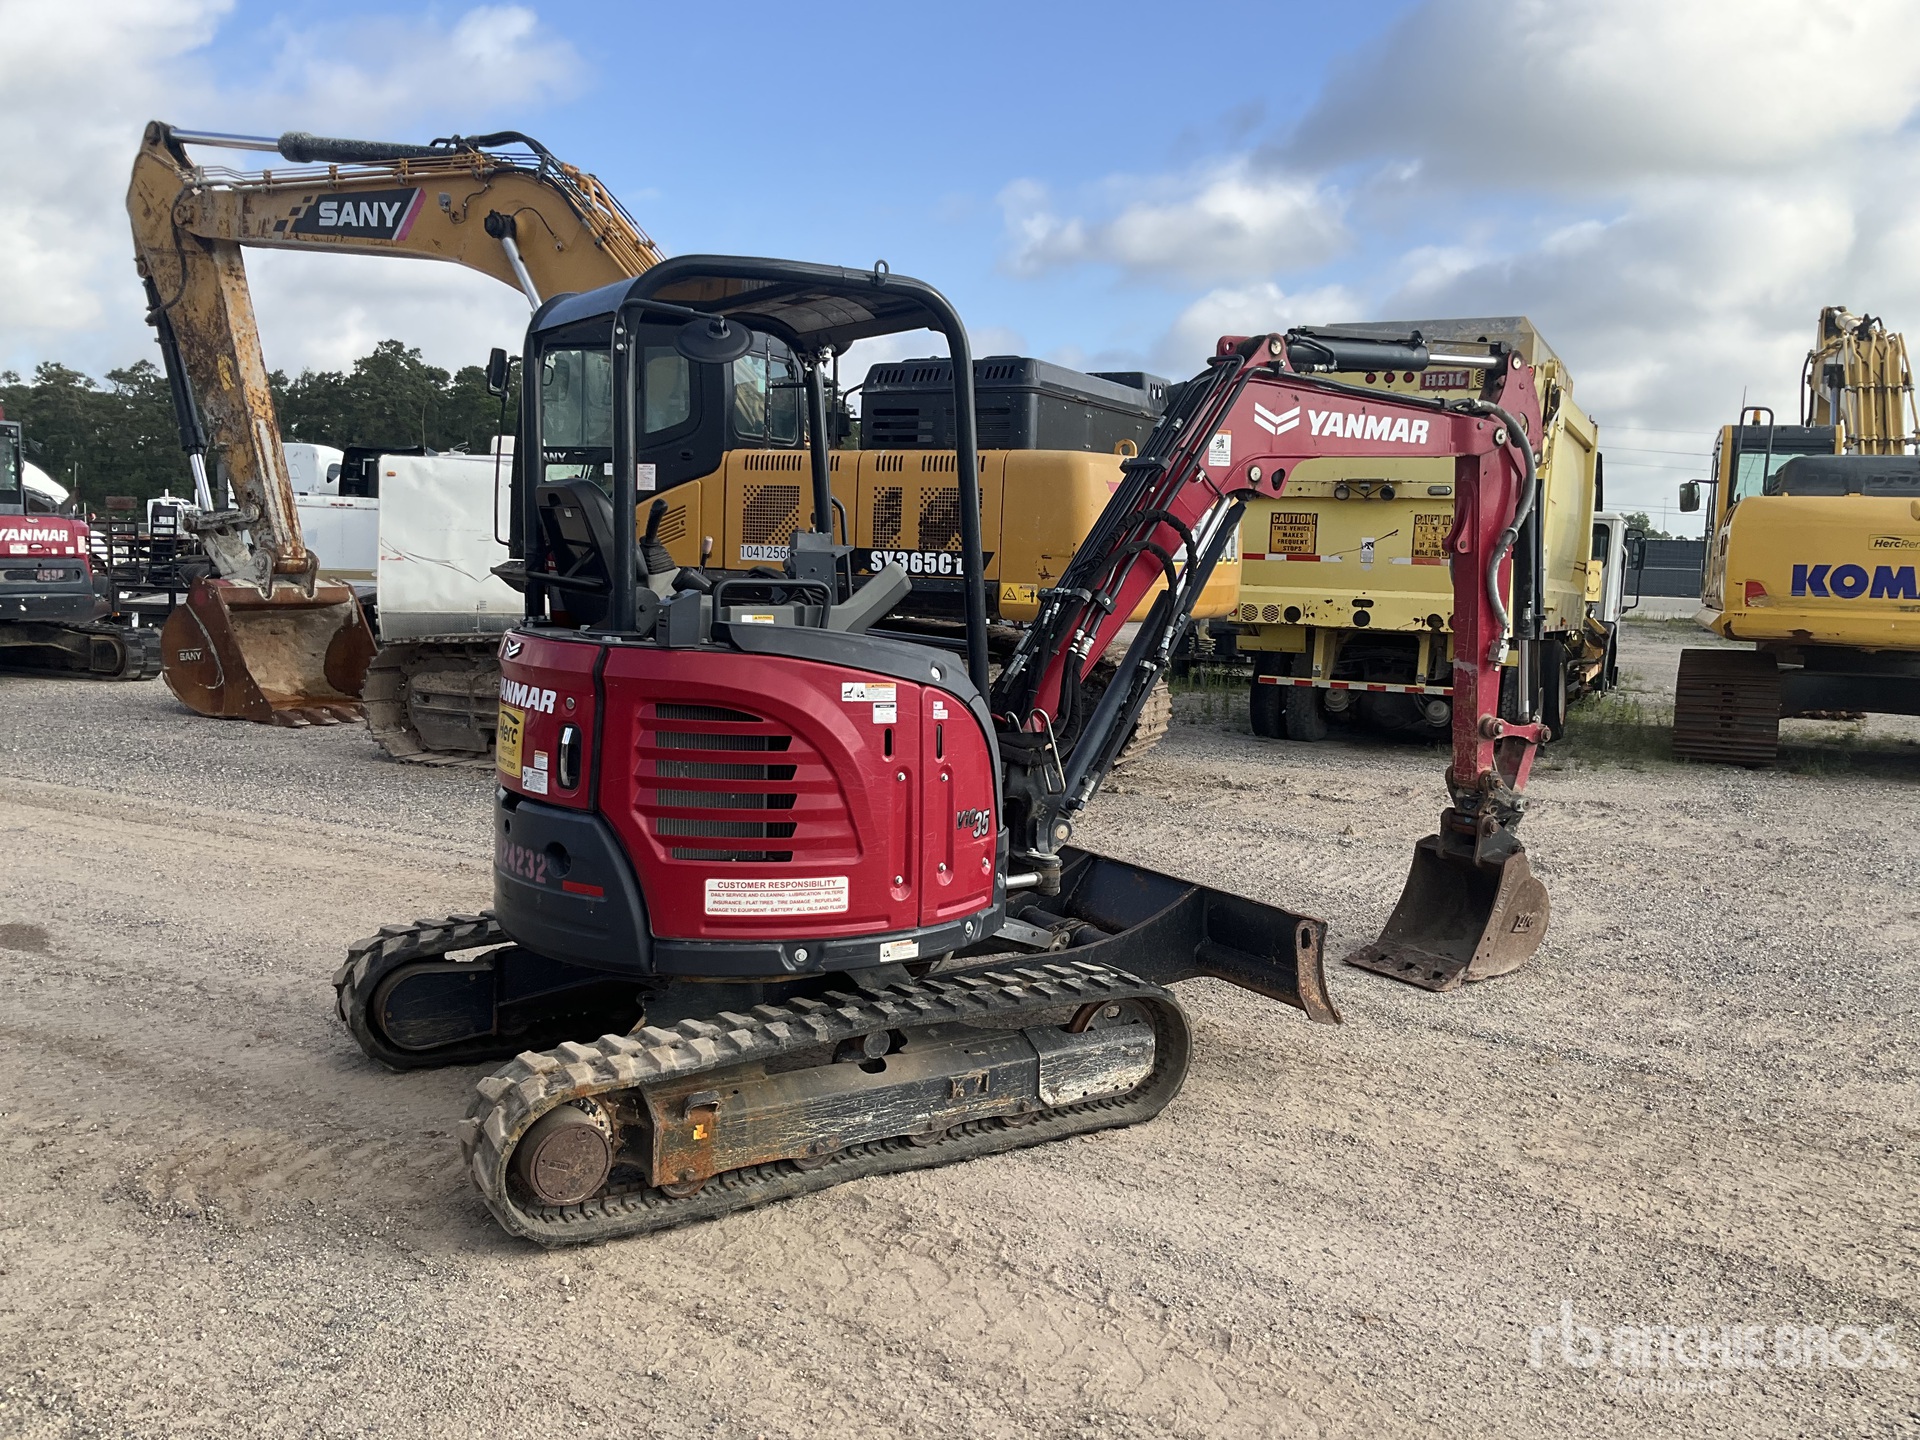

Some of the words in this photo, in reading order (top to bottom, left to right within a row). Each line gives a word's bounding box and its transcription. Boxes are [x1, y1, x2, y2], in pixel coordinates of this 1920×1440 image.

[318, 201, 401, 227] SANY
[1425, 373, 1465, 387] HEIL
[1307, 409, 1429, 444] YANMAR
[542, 452, 566, 462] ANY
[1791, 564, 1920, 599] KOM
[179, 651, 201, 661] SANY
[500, 676, 556, 714] ANMAR
[717, 881, 766, 889] CUSTOMER
[768, 879, 837, 888] RESPONSIBILITY
